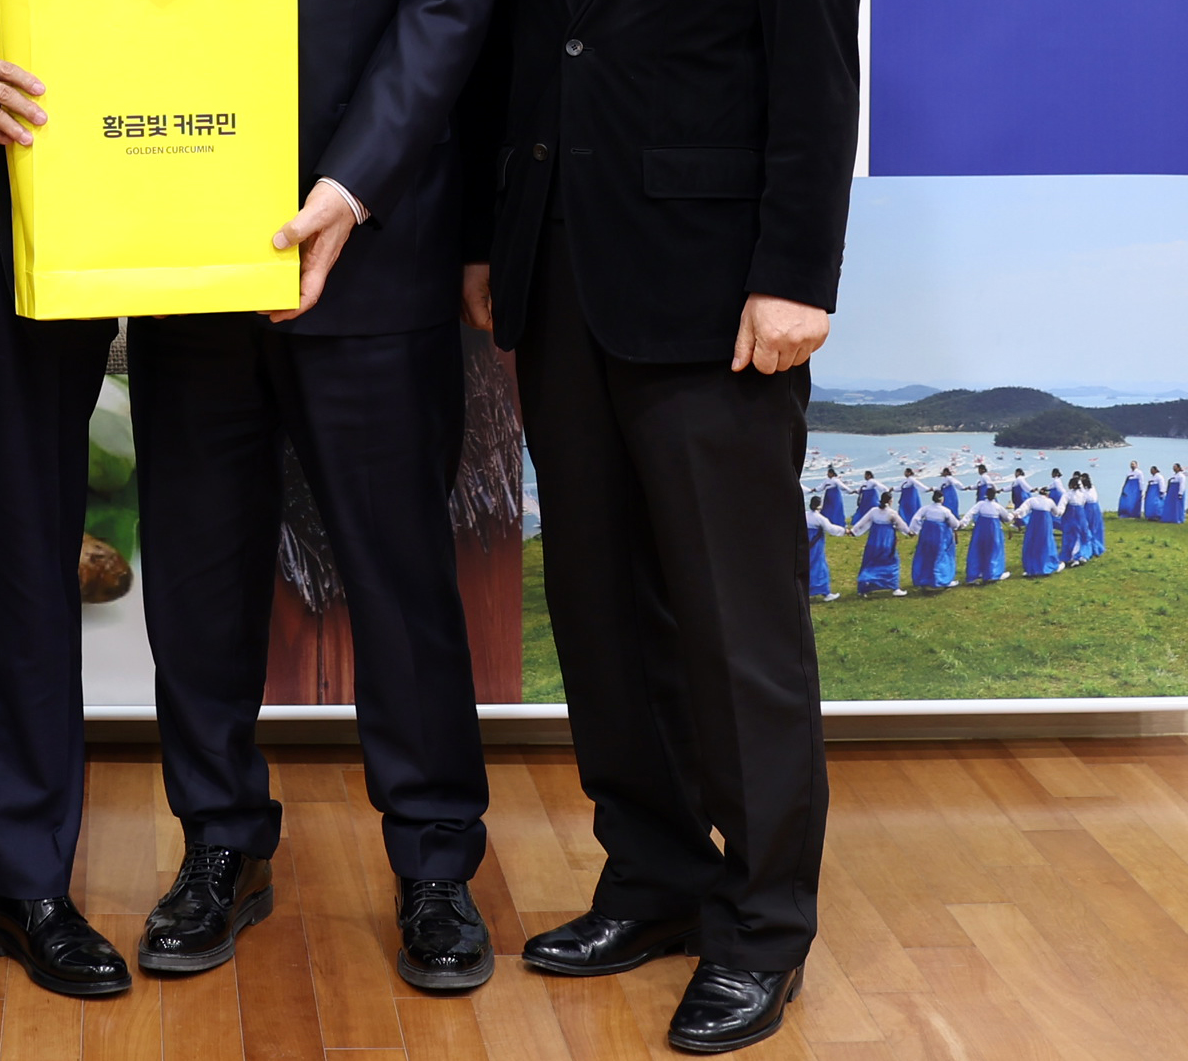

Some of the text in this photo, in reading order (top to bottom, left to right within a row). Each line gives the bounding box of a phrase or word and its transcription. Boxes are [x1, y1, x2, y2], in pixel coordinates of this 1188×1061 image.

[102, 112, 236, 139] 황금빛 커큐민
[125, 145, 215, 155] GOLDEN CURCUMIN
